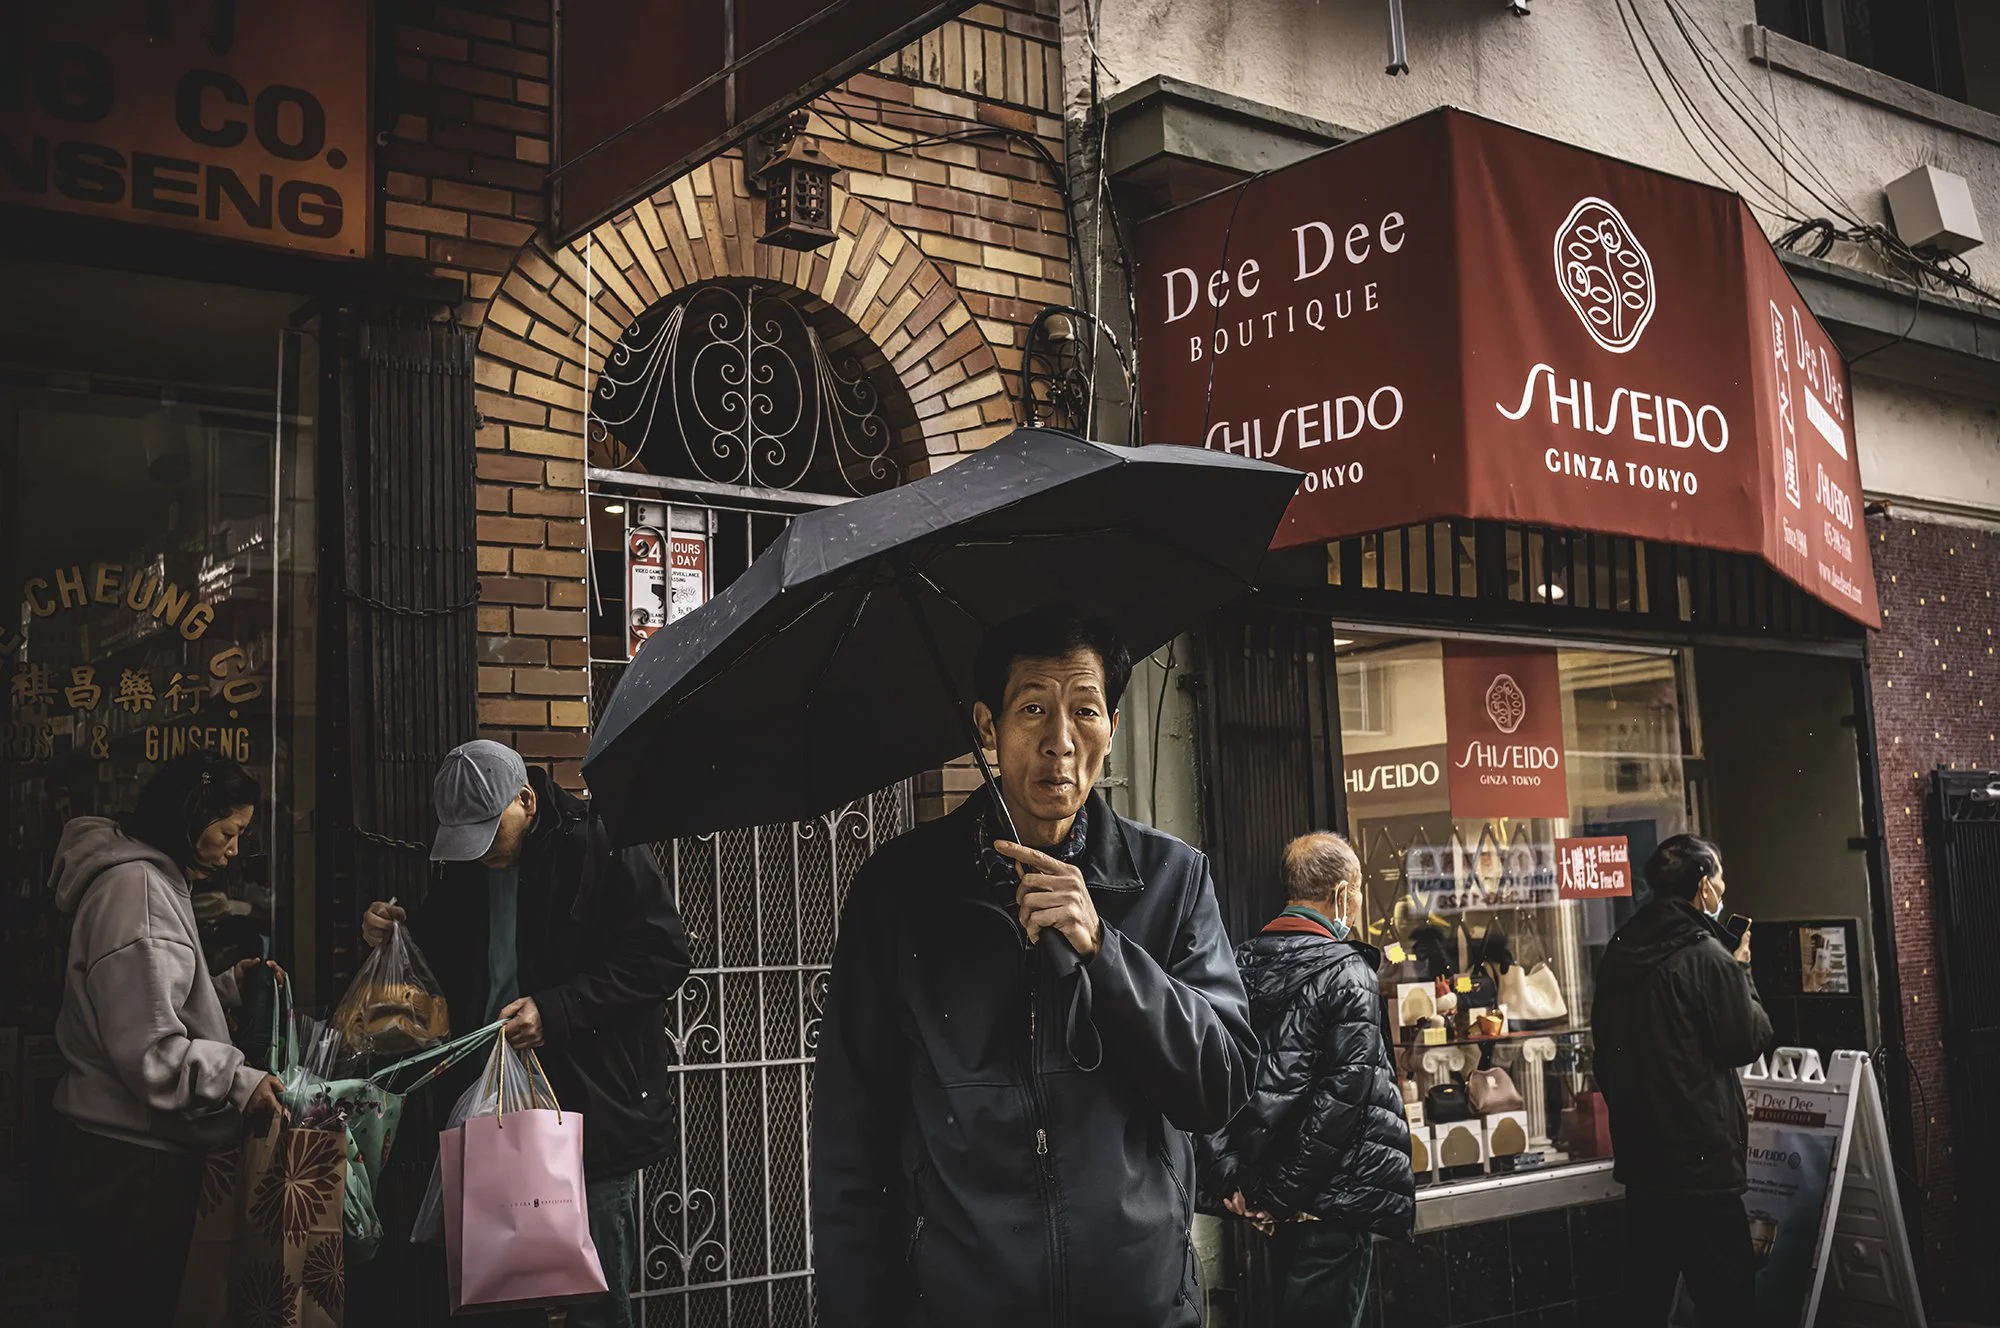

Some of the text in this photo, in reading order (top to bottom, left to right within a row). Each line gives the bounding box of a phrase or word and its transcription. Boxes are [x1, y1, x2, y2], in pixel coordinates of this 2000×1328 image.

[175, 68, 347, 169] CO.
[1162, 211, 1405, 324] Dee Dee
[1190, 282, 1379, 362] BOUTIQUE
[1791, 304, 1819, 390] Dee
[1819, 345, 1845, 421] Dee
[1496, 363, 1729, 453] SHISEIDO
[1295, 461, 1364, 495] OKYO
[1545, 448, 1698, 495] GINZA TOKYO
[1815, 462, 1854, 531] SHISEIDO
[635, 538, 661, 563] 24
[24, 563, 215, 641] CHEUNG
[90, 724, 110, 760] &
[145, 726, 250, 764] GINSENG
[1455, 740, 1559, 770] SHISEIDO
[1344, 760, 1439, 793] HISEIDO
[1479, 774, 1541, 786] GINZA TOKYO
[1762, 1093, 1786, 1108] Dee
[1788, 1096, 1814, 1111] Dee
[1747, 1147, 1787, 1162] HISEIDO
